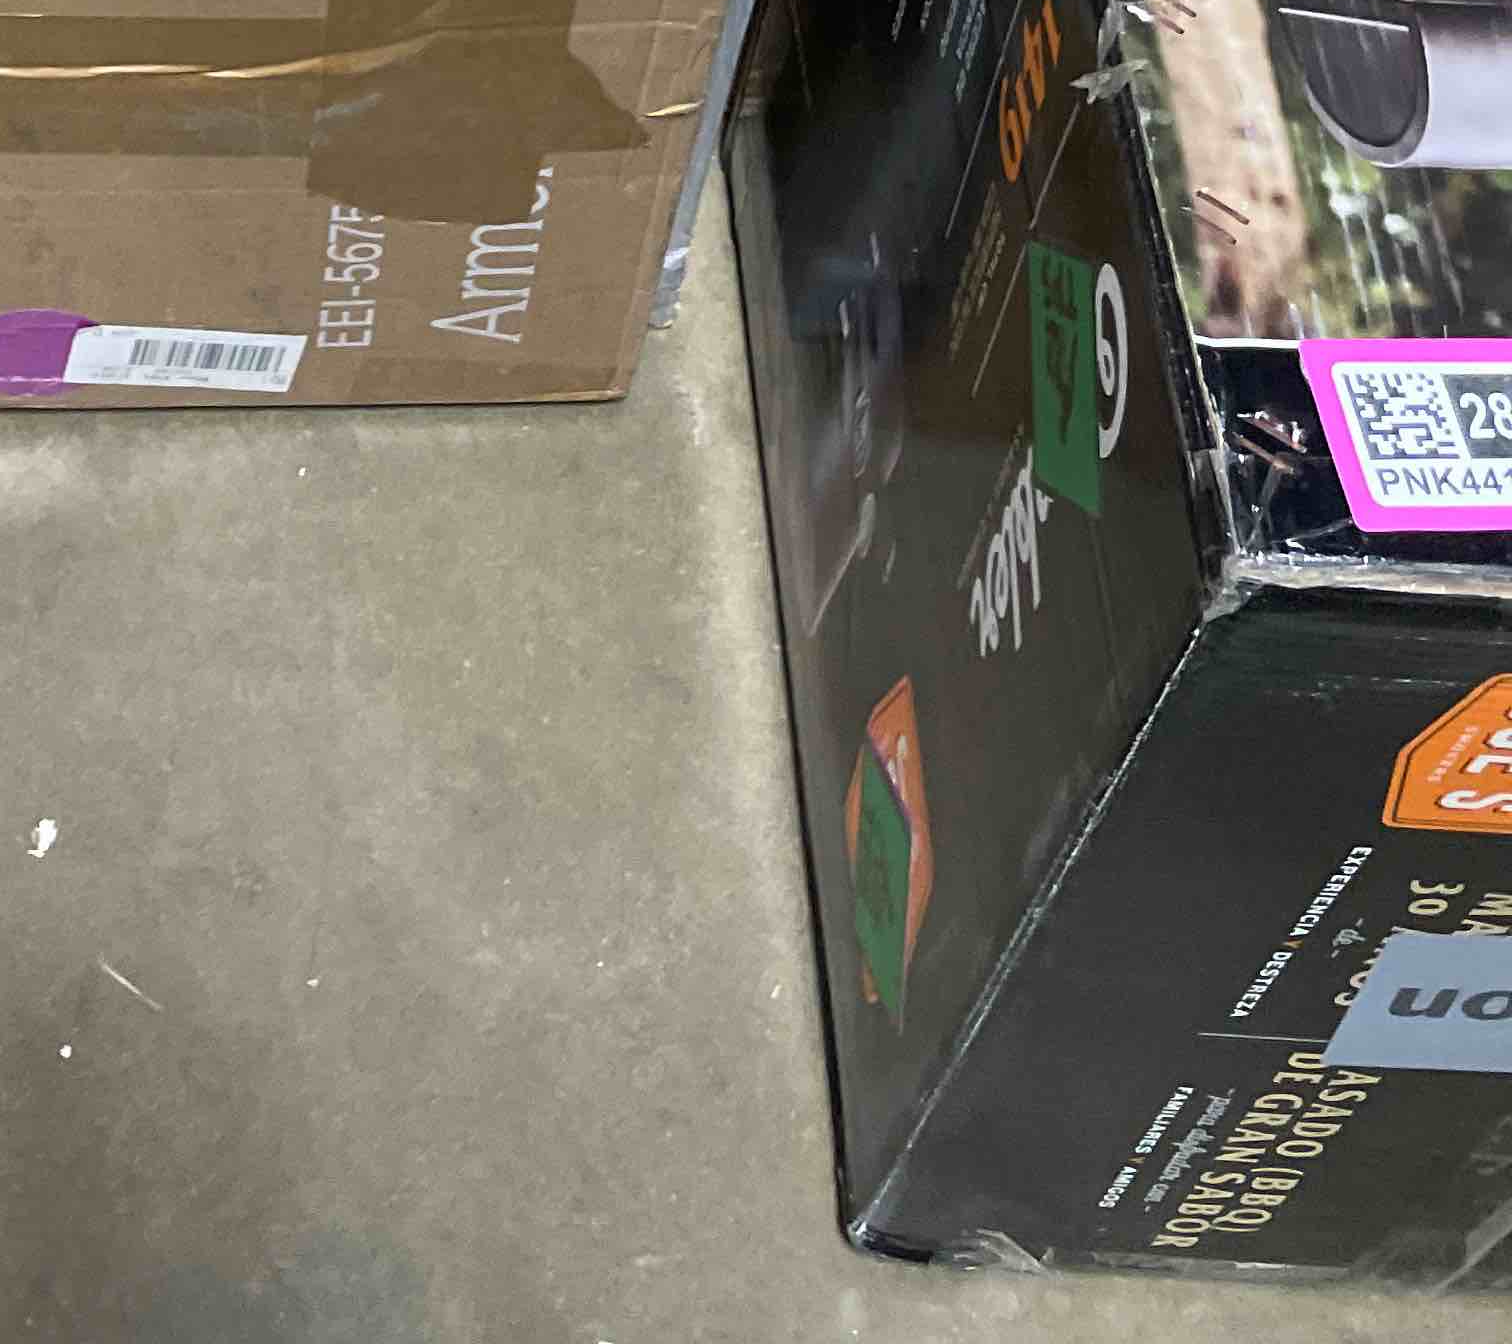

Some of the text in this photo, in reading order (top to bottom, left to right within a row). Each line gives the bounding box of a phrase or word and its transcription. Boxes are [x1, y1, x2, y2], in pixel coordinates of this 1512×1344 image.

[1460, 392, 1512, 440] 28
[1304, 845, 1372, 936] EXPERIENCIA
[1230, 950, 1292, 1019] DESTREZA
[1135, 1086, 1194, 1154] FAMILIARES
[1210, 1070, 1382, 1232] ASADO (BBQ)
[1214, 1093, 1303, 1163] GRAN
[1098, 1166, 1138, 1209] AMIGOS
[1150, 1171, 1246, 1248] SABOR
